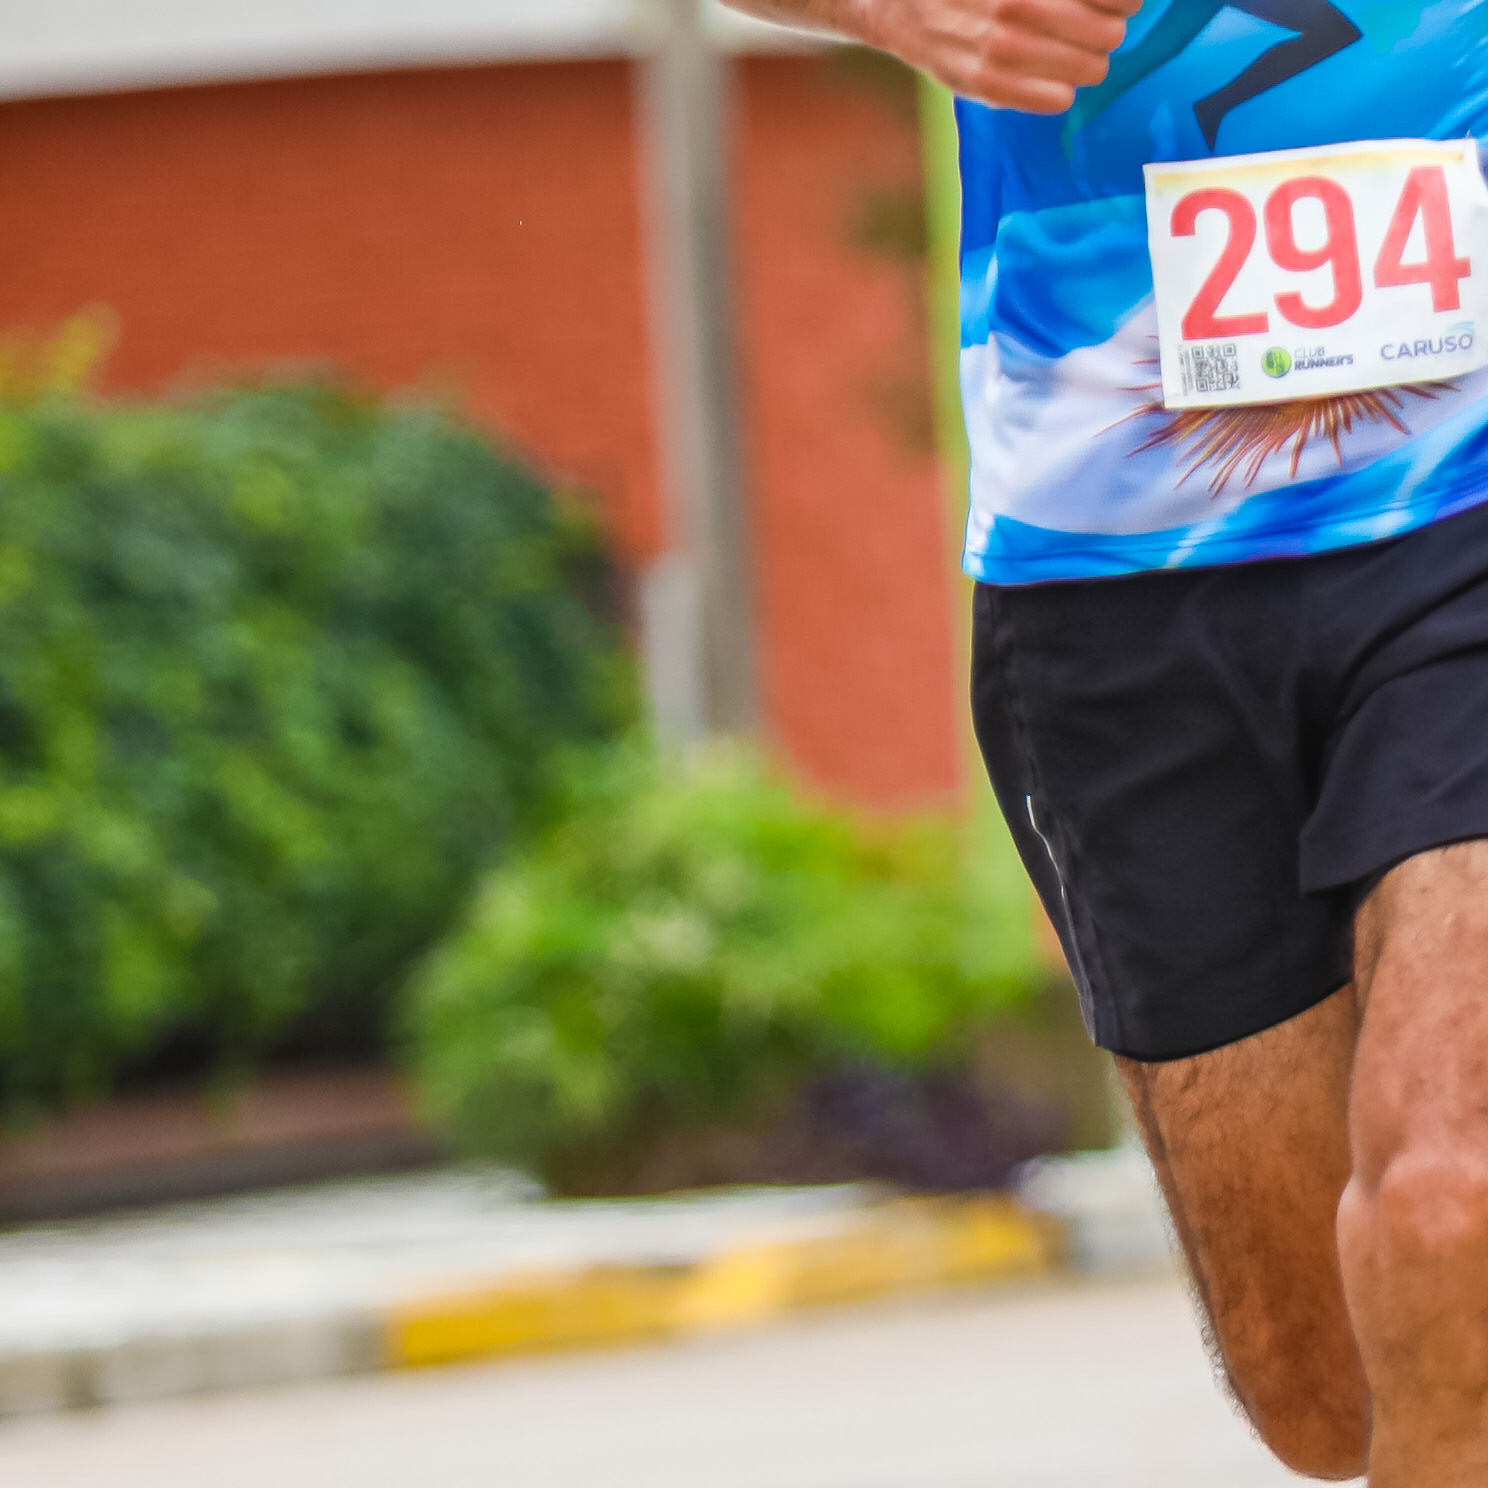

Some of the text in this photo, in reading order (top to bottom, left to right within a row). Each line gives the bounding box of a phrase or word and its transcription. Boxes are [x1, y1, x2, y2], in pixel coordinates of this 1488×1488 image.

[1170, 165, 1471, 341] 294
[1294, 346, 1325, 358] CLUB
[1380, 334, 1474, 361] CARUSO
